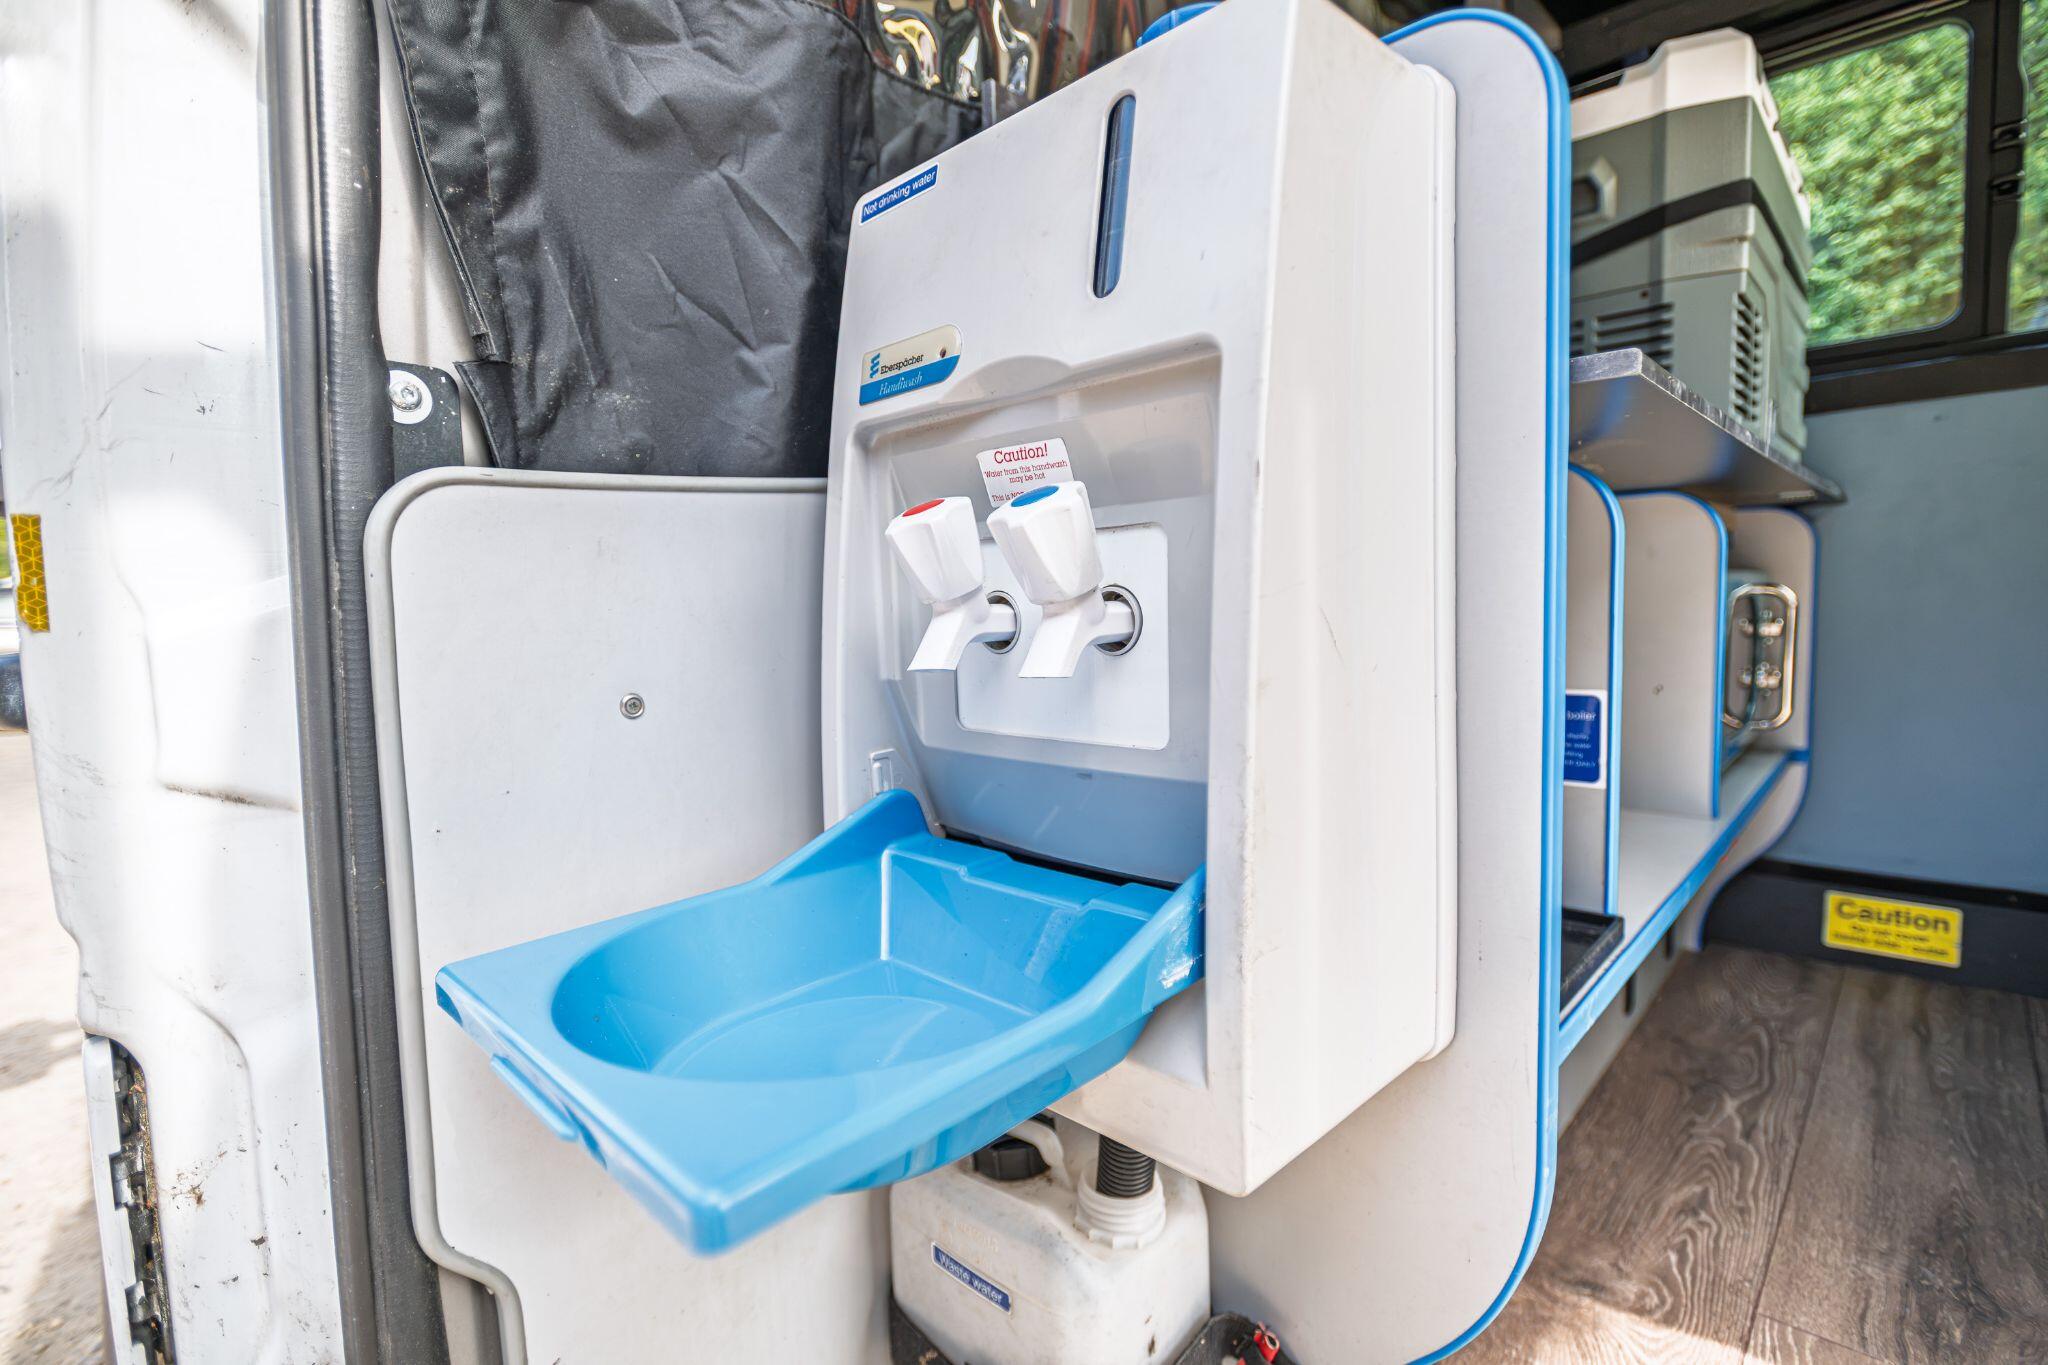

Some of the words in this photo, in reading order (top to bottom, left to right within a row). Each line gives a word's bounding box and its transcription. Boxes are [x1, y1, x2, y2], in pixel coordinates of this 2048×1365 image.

[863, 203, 877, 216] Not
[879, 184, 911, 208] drinking
[912, 171, 936, 190] water
[879, 371, 923, 396] Handiwash
[994, 442, 1048, 464] Caution!
[984, 470, 1003, 478] Water
[1004, 468, 1019, 476] from
[1019, 466, 1031, 474] this
[1032, 460, 1068, 472] handwash
[1009, 476, 1024, 484] may
[1034, 472, 1046, 480] hot
[992, 494, 1004, 502] This
[1005, 493, 1010, 501] is
[1567, 710, 1596, 721] boiler
[1836, 898, 1950, 934] Caution
[938, 1250, 970, 1284] Waste
[971, 1277, 1002, 1303] water
